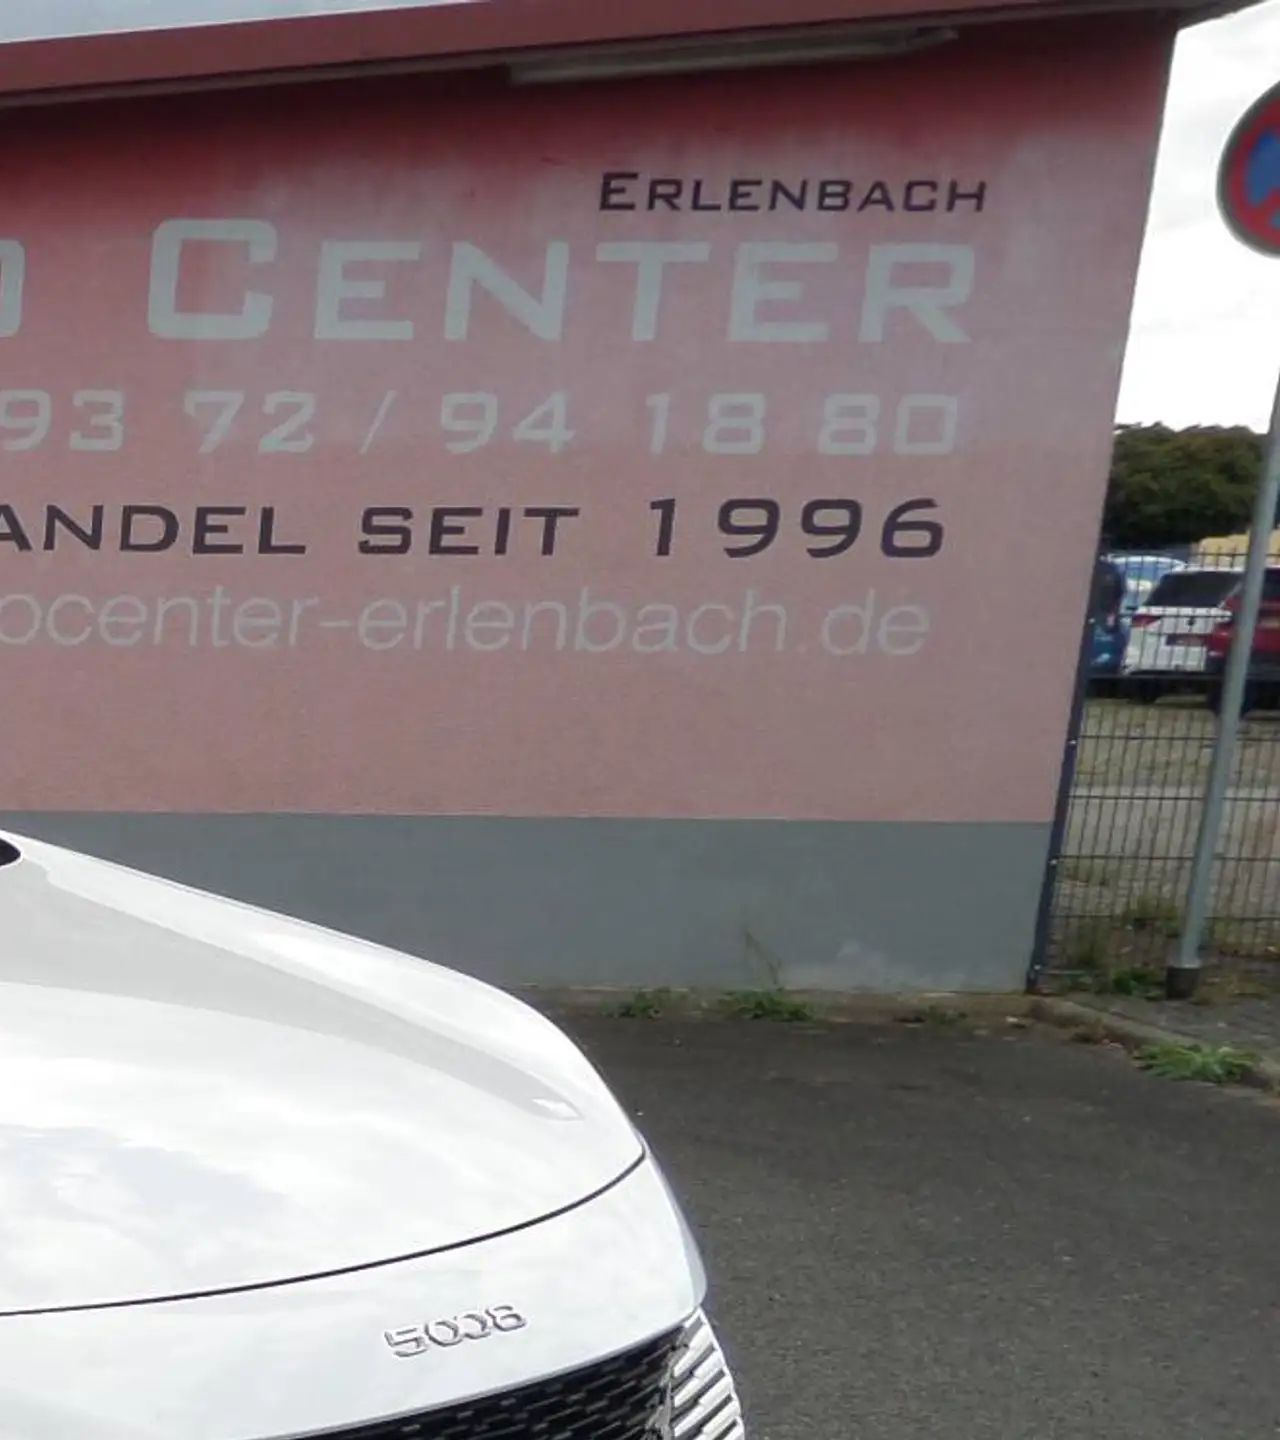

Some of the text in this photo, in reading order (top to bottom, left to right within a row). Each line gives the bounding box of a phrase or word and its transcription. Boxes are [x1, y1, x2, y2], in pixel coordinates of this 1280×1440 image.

[598, 171, 988, 214] ERLENBACH
[146, 216, 977, 344] CENTER
[182, 389, 319, 455] 72
[439, 390, 578, 455] 94
[645, 392, 768, 457] 18
[817, 392, 960, 457] 80
[357, 505, 581, 558] SEIT
[648, 497, 946, 559] 1996
